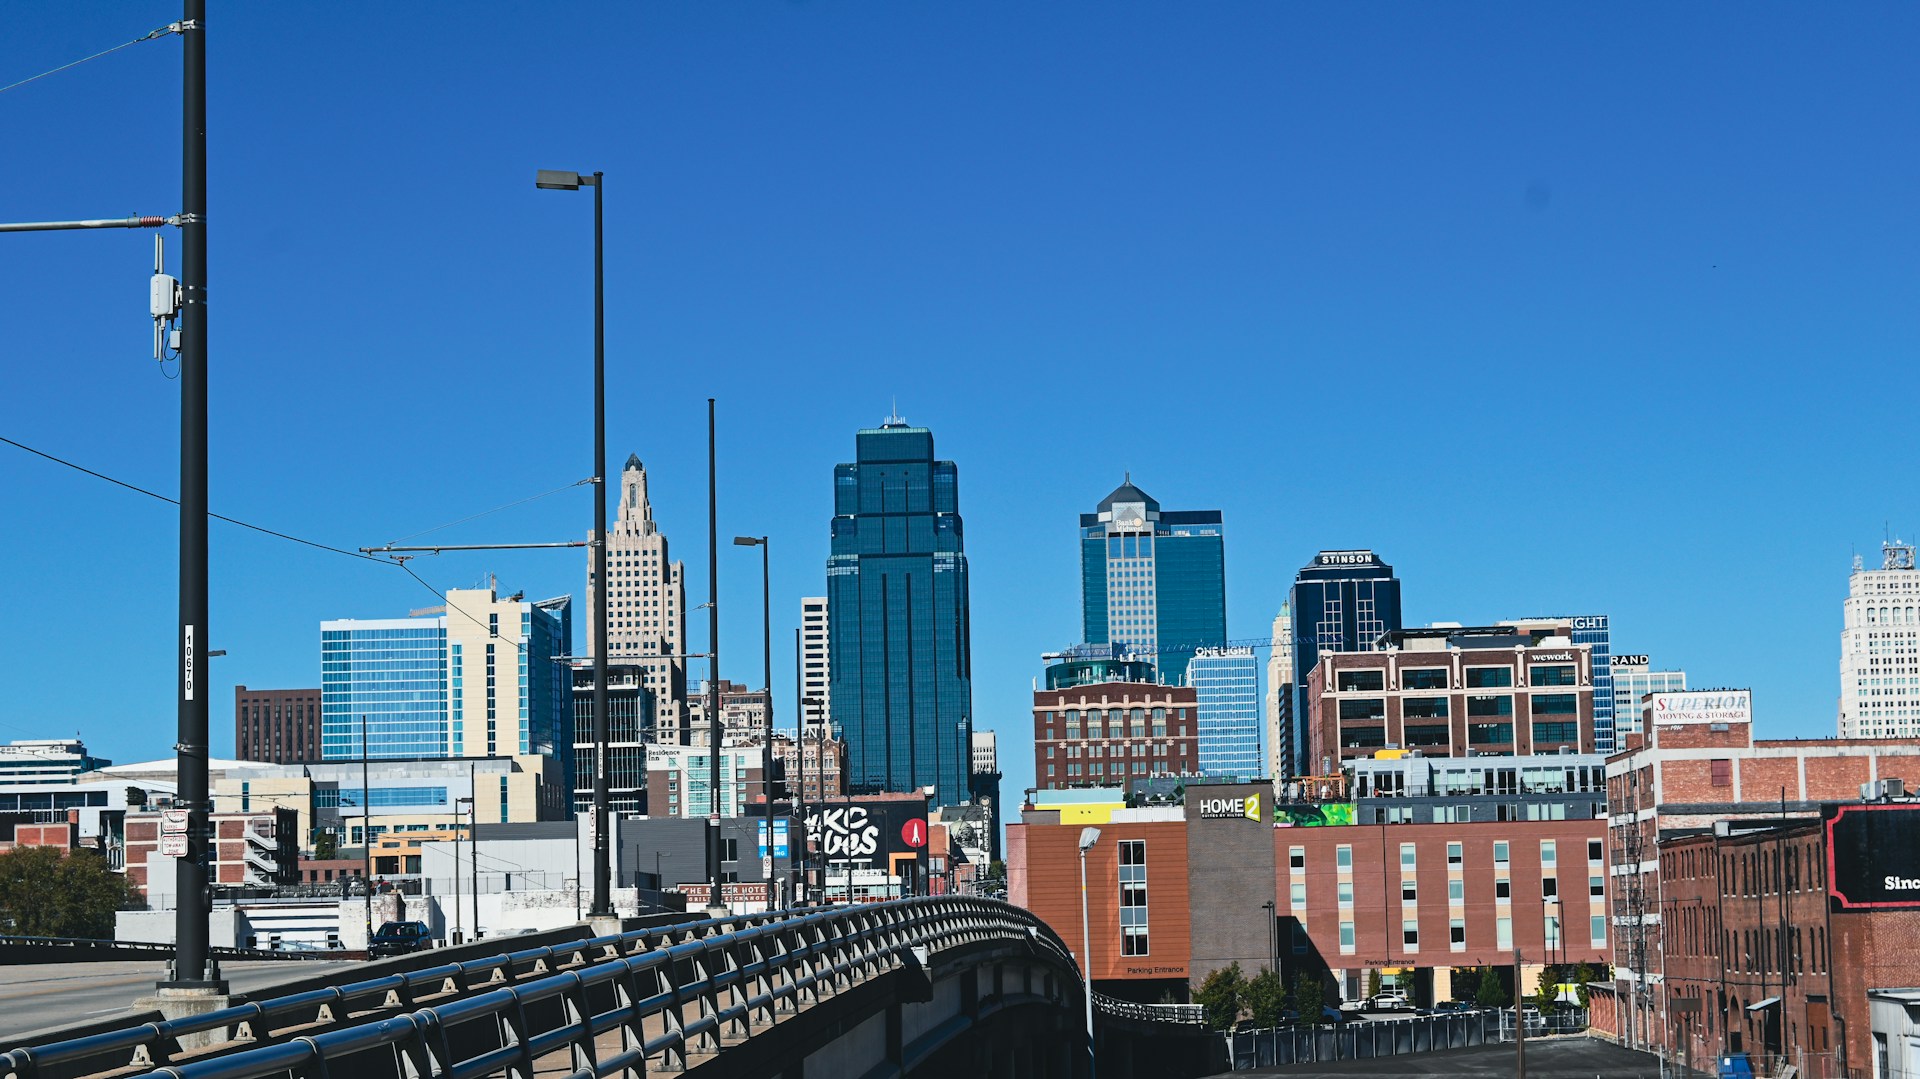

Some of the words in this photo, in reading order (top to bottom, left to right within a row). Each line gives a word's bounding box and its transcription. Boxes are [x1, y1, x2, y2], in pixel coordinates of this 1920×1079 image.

[1322, 555, 1373, 564] STINSON
[1571, 616, 1605, 629] IGHT
[1195, 646, 1219, 656] ONE
[1221, 646, 1252, 655] LIGHT
[1531, 651, 1574, 661] wework
[1610, 655, 1649, 665] RAND
[1656, 695, 1747, 711] SUPERIOR
[1658, 712, 1695, 720] MOVING
[1705, 711, 1746, 719] STORAGE
[1365, 959, 1387, 967] Parking
[1127, 967, 1153, 975] Parking
[1154, 966, 1184, 974] Entrance
